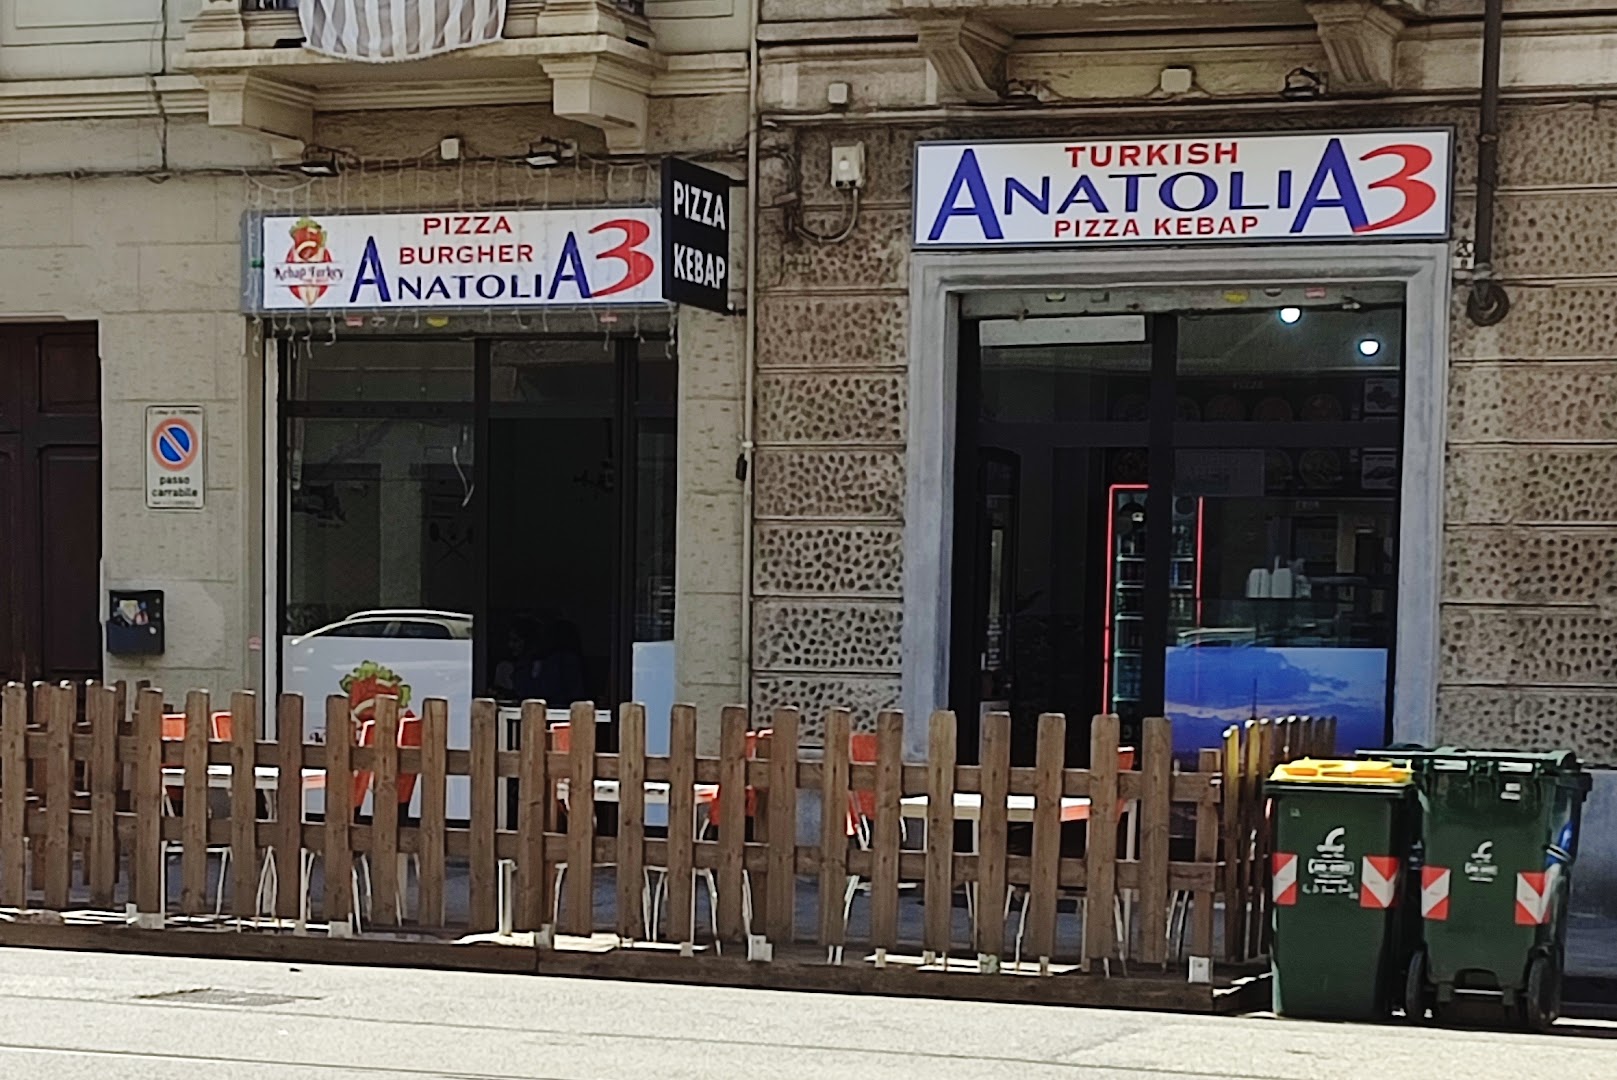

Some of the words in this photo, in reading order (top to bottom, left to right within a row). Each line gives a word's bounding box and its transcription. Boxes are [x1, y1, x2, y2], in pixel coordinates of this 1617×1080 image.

[1065, 143, 1239, 168] TURKISH
[673, 180, 726, 230] PIZZA
[424, 216, 511, 235] PIZZA
[1055, 219, 1139, 237] PIZZA
[1155, 217, 1258, 235] KEBAP
[400, 245, 533, 264] BURGHER
[673, 243, 726, 289] KEBAP
[159, 476, 191, 486] passo
[151, 487, 199, 498] carrabile
